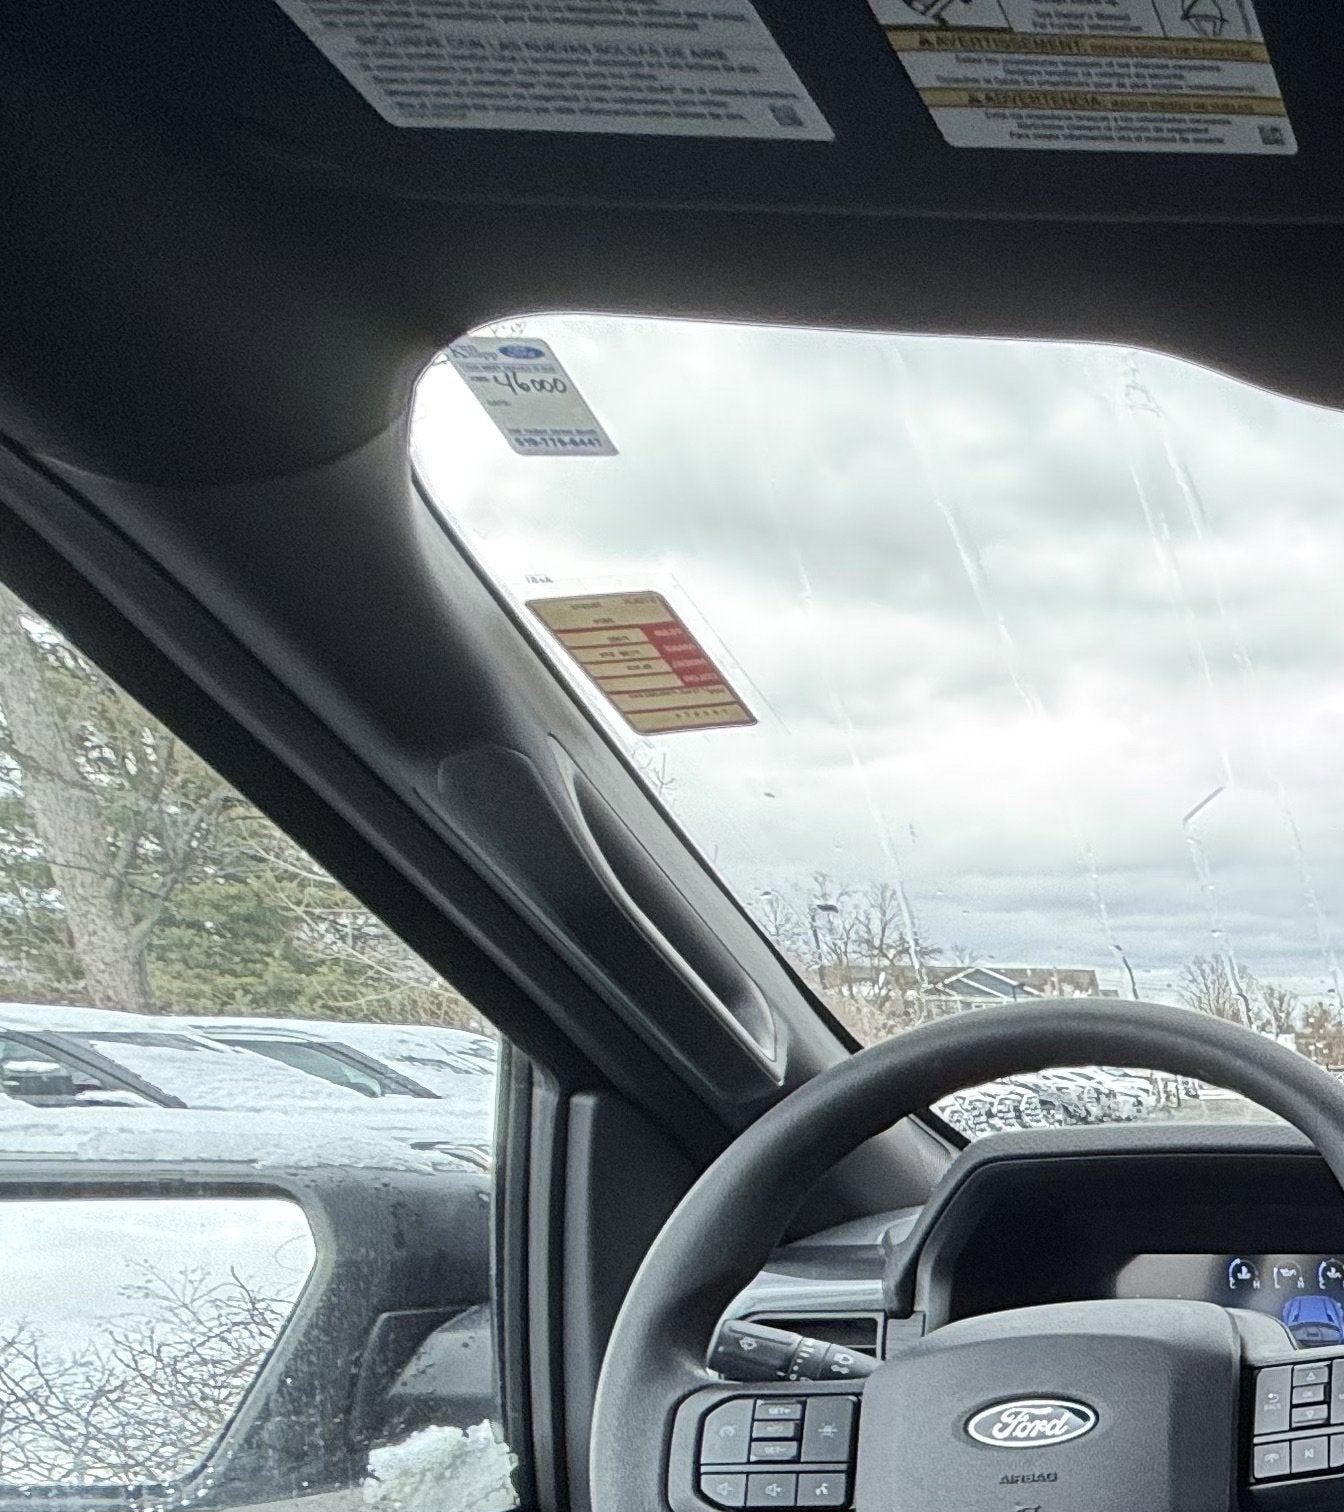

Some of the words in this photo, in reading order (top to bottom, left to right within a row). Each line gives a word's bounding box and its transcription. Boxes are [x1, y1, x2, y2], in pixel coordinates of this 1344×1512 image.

[493, 371, 567, 396] 46000
[991, 1405, 1072, 1440] Ford
[998, 1471, 1058, 1485] AIRBAG
